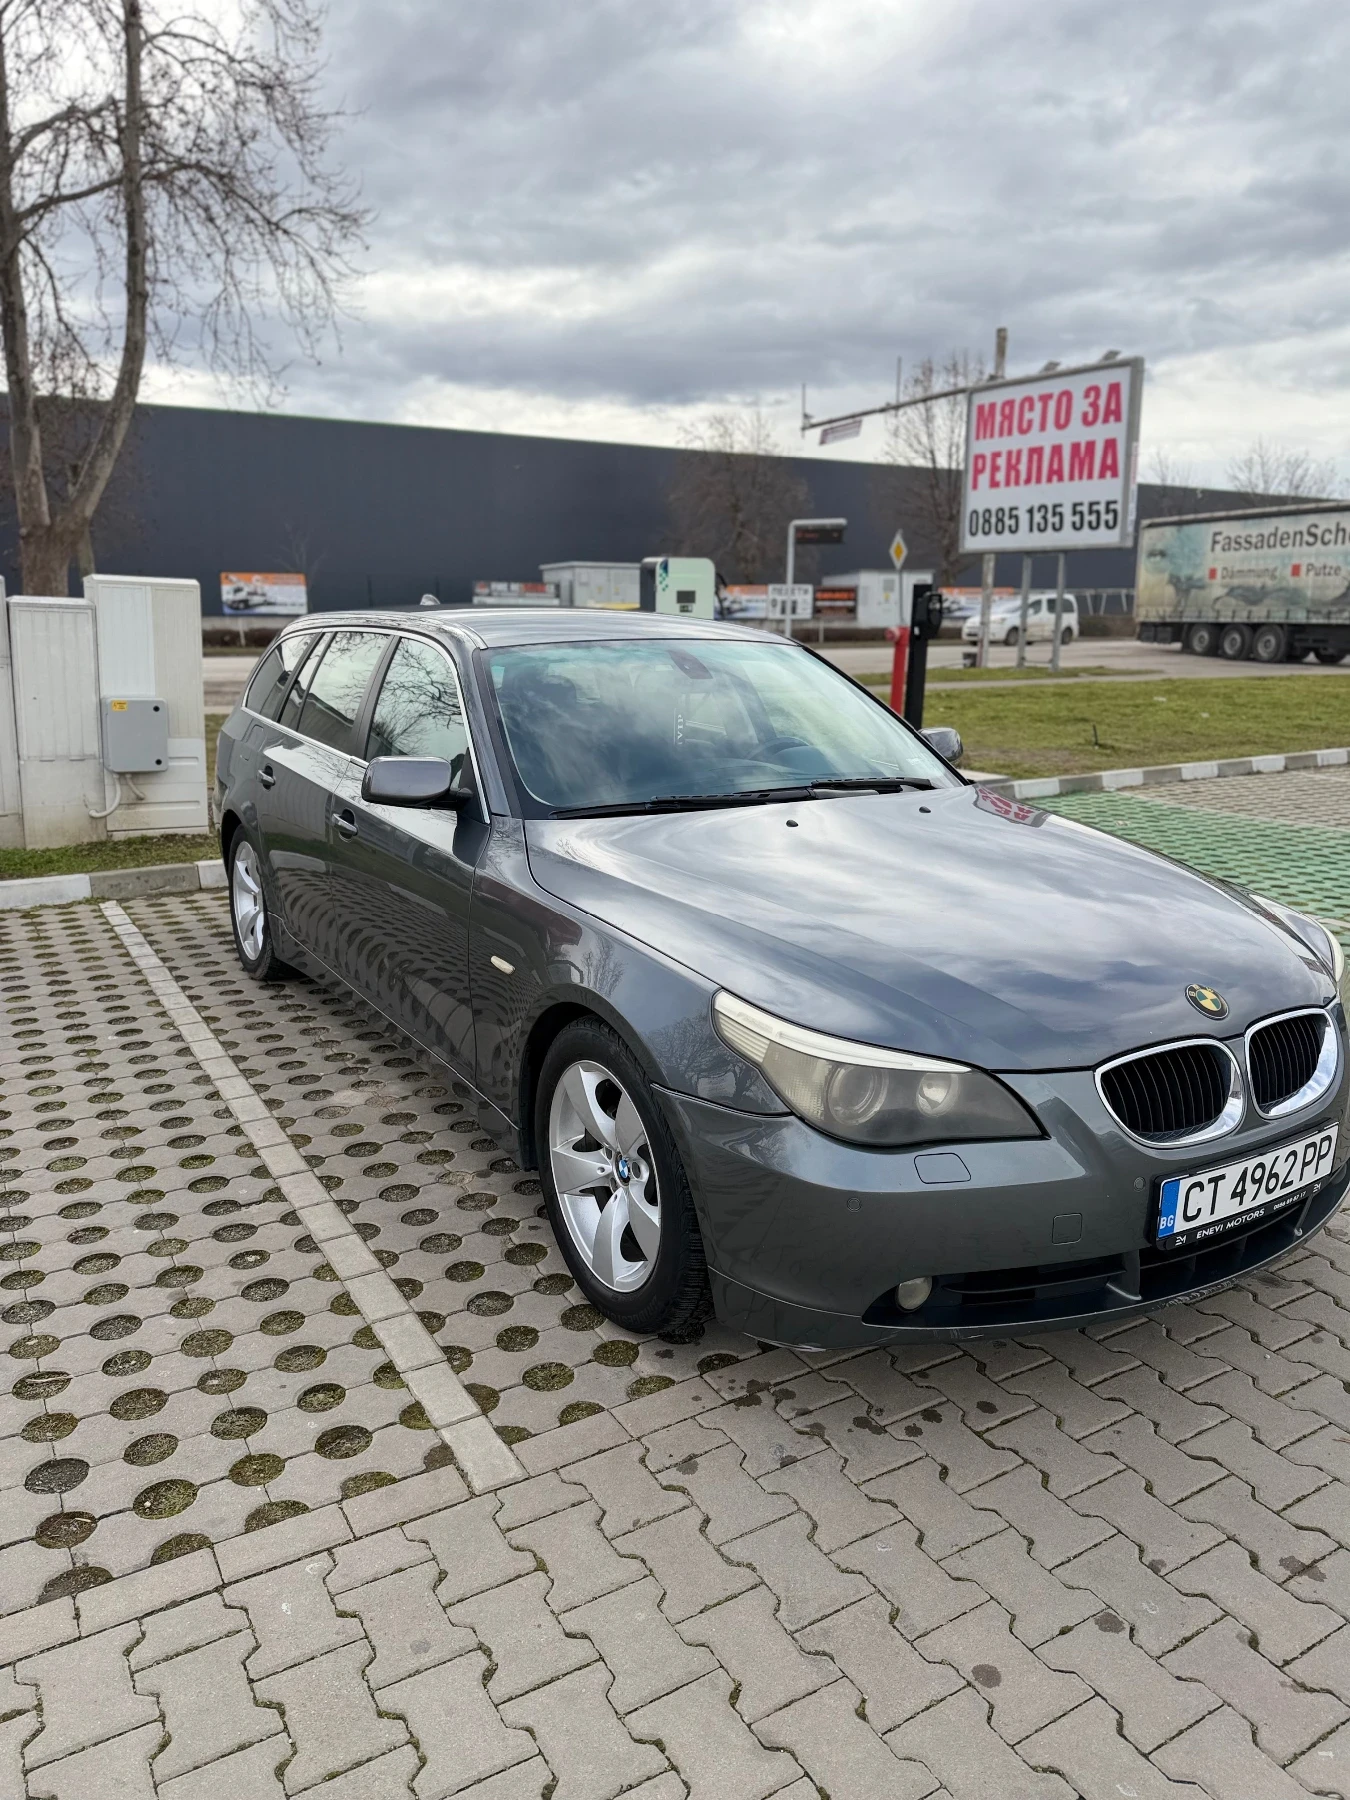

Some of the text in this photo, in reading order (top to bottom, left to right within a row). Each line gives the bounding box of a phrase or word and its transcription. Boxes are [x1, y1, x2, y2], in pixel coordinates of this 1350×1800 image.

[975, 382, 1122, 441] МЯСТО ЗА
[971, 437, 1119, 491] РЕКЛАМА
[969, 500, 1118, 537] 0885 135 555
[1305, 562, 1342, 577] Putze
[1182, 1135, 1333, 1222] CT 4962 PP
[1160, 1215, 1175, 1230] BG
[1196, 1208, 1265, 1239] ENEVI MOTORS
